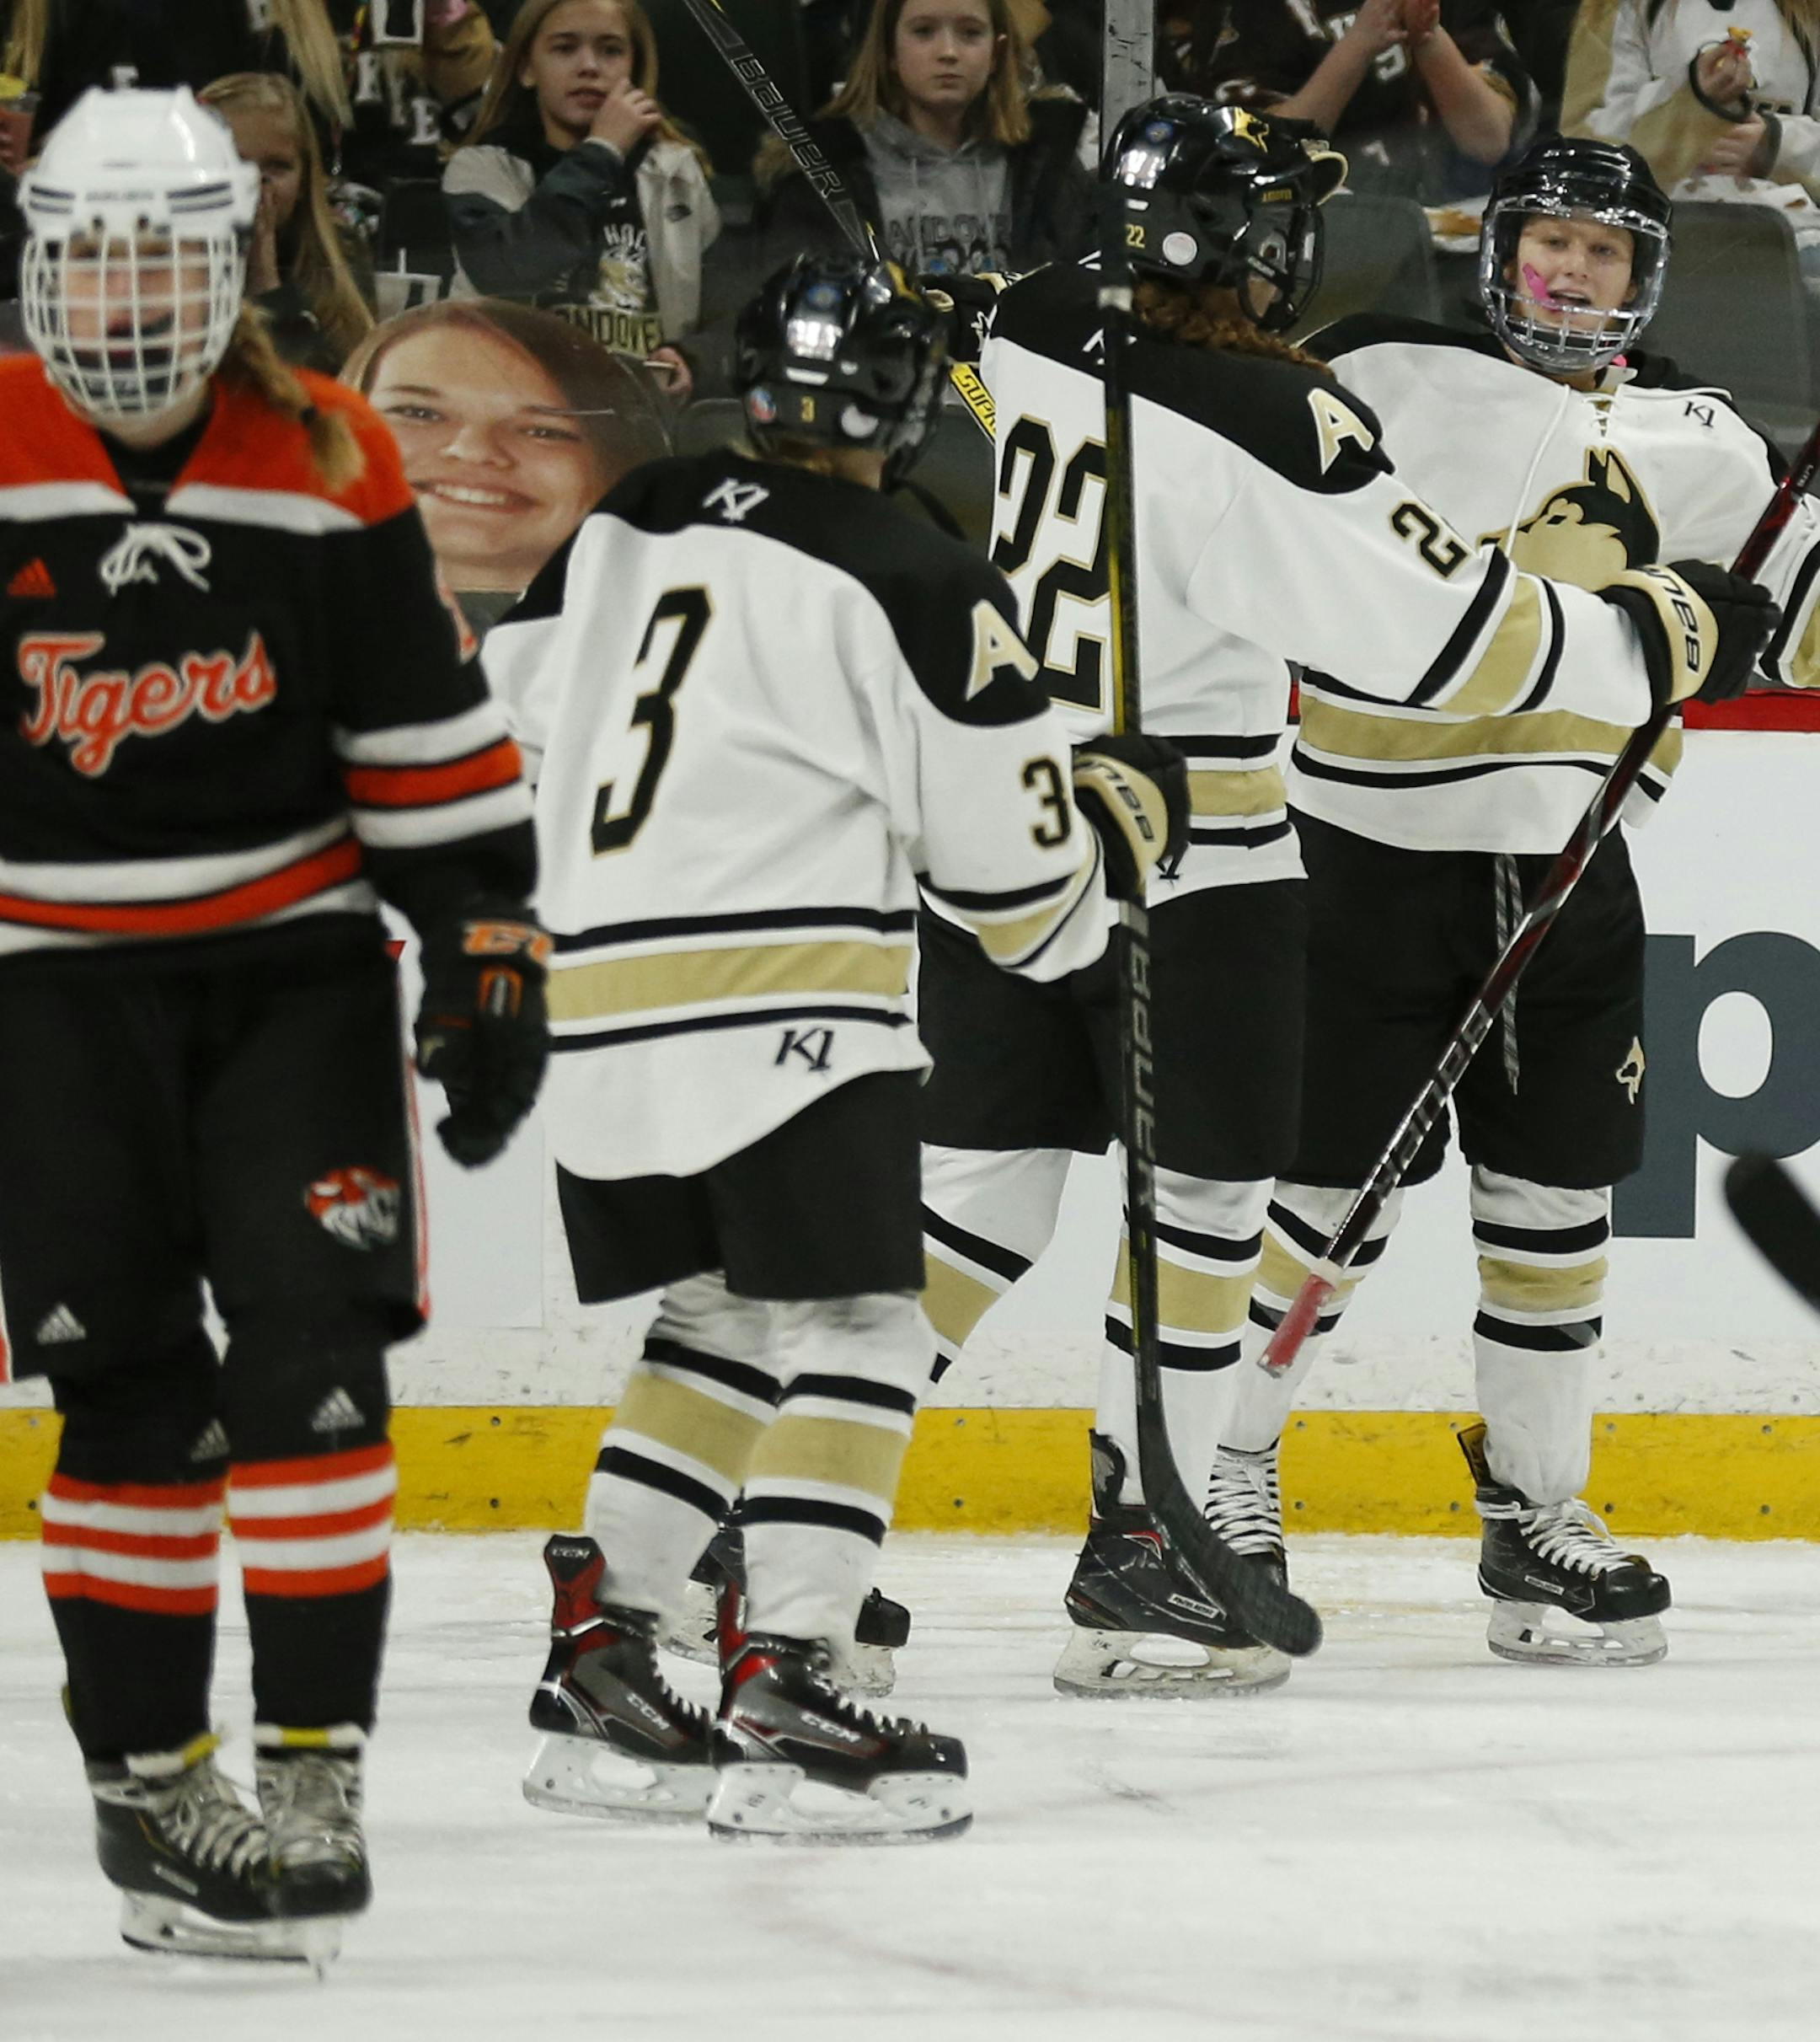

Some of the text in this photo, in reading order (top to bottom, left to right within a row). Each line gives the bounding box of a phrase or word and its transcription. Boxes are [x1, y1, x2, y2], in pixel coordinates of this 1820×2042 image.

[731, 53, 845, 199] BAUER
[1126, 223, 1146, 249] 22
[801, 396, 816, 422] 3
[1307, 386, 1375, 475] A
[966, 599, 1040, 701] A
[19, 630, 277, 777] Tigers
[590, 584, 716, 862] 3
[1020, 755, 1072, 849] 3
[626, 1691, 671, 1730] CCM
[800, 1710, 861, 1743] CCM
